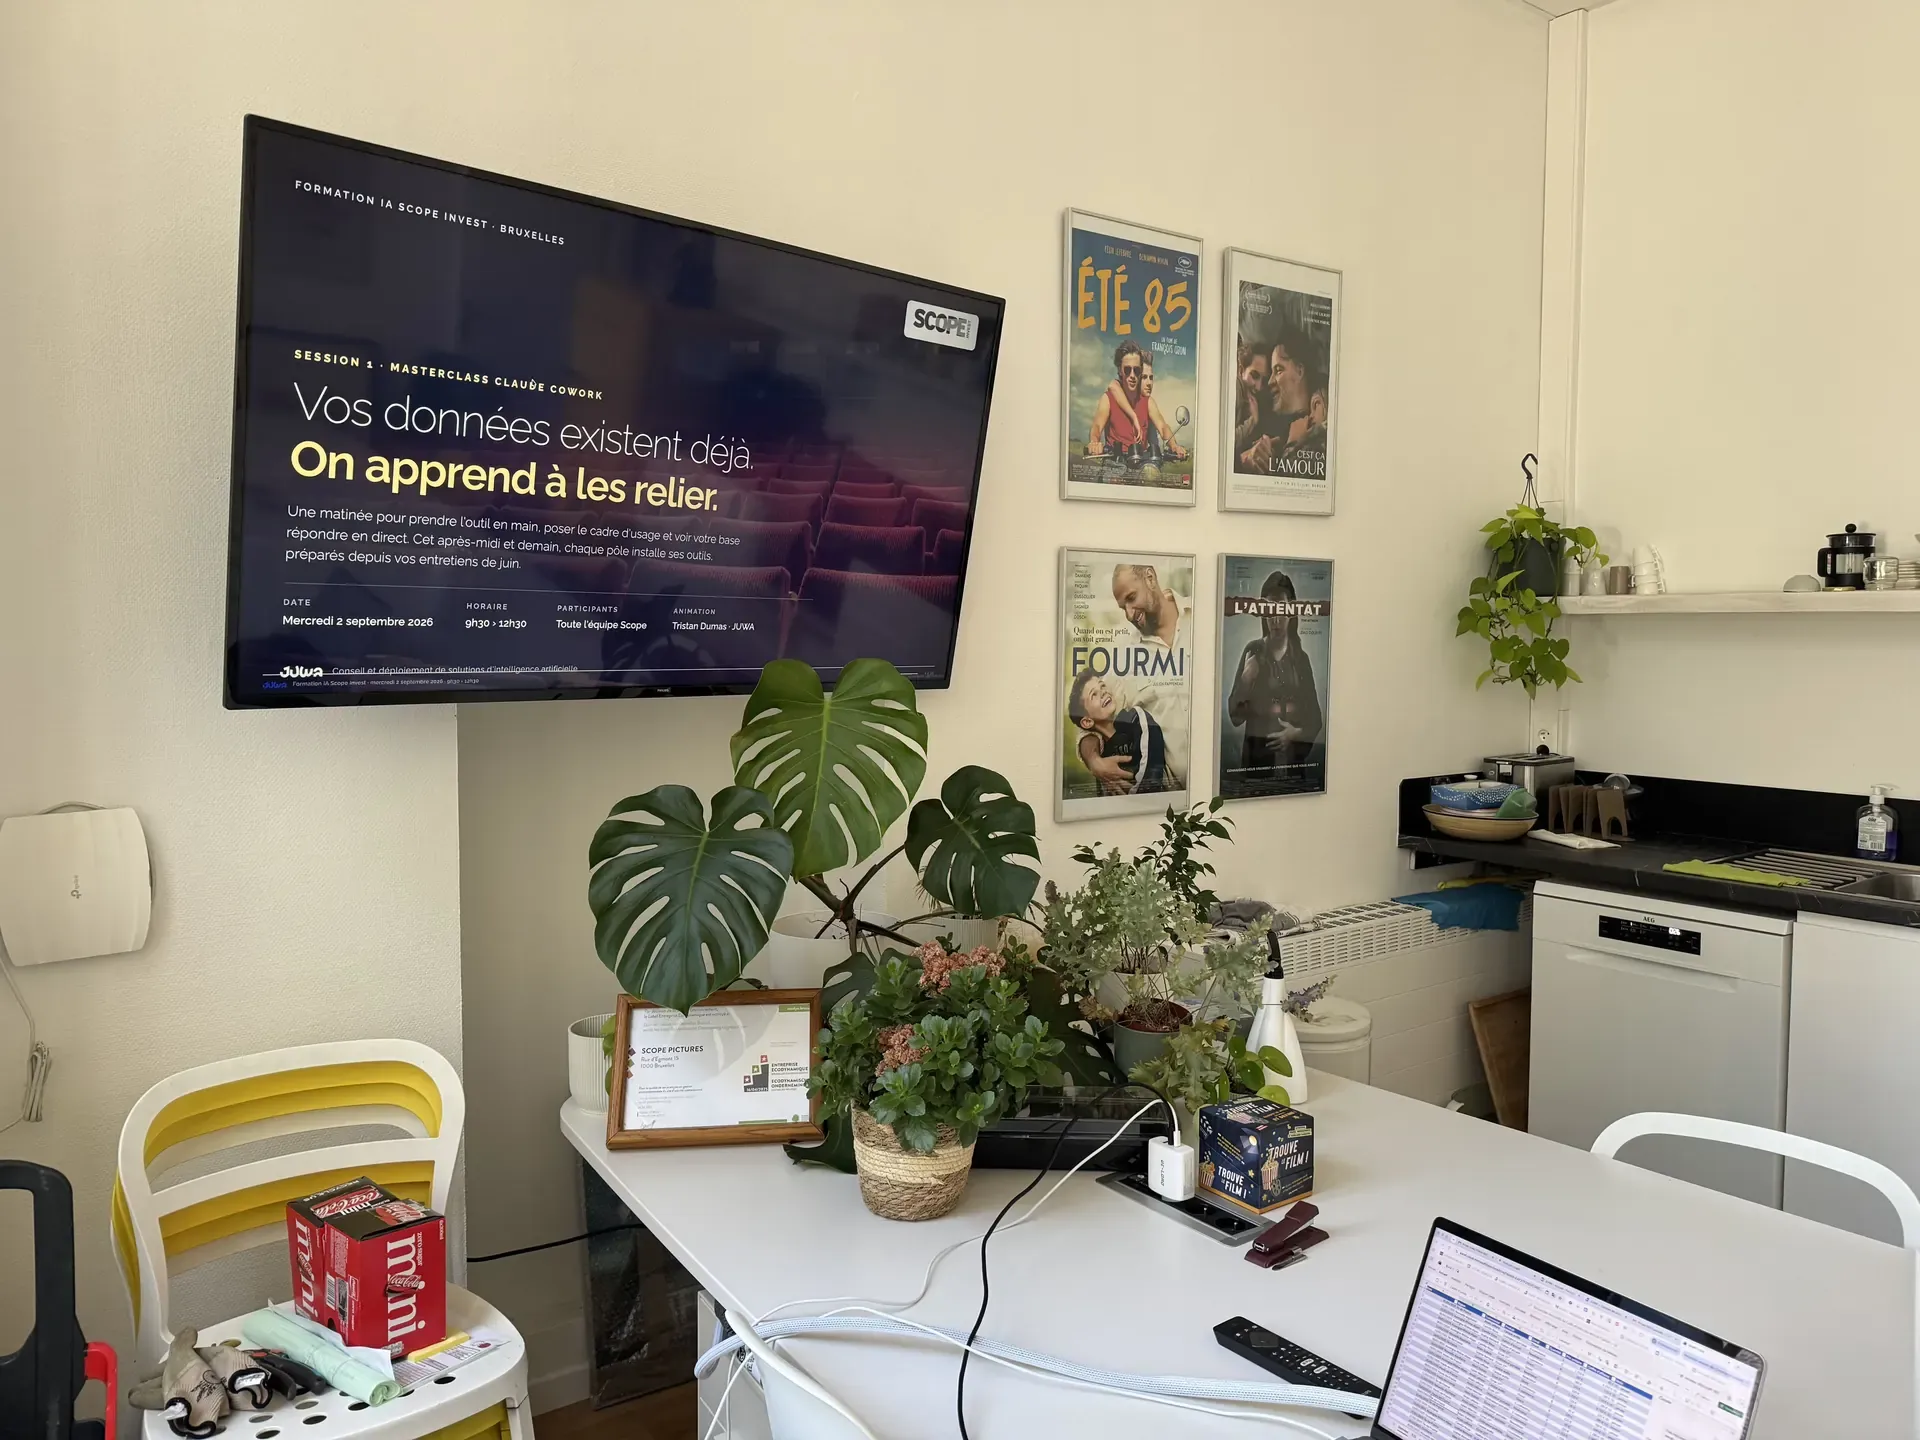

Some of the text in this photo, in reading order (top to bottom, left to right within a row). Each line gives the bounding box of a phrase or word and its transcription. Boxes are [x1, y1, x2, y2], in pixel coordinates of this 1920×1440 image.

[295, 180, 565, 245] FORMATION IA SCOPE INVEST BRUXELLES
[1077, 256, 1192, 335] ÉTÉ 85
[913, 308, 967, 338] SCOPE
[294, 350, 360, 367] SESSION
[366, 361, 373, 369] 1
[390, 363, 489, 384] MASTERCLASS
[550, 385, 603, 400] COWORK
[294, 382, 754, 474] Vos données existent déjà.
[291, 440, 718, 511] On apprend à les relier.
[1269, 457, 1325, 476] L'AMOUR
[288, 505, 741, 546] Une matinée pour prendre l'outil en main, poser le cadre d'usage et voir votre base
[286, 526, 713, 562] répondre en direct. Cet après-midi et demain, chaque pôle installe ses outils.
[285, 549, 522, 570] préparés depuis vos entretiens de juin.
[283, 598, 311, 607] DATE
[466, 602, 508, 611] HORAIRE
[557, 604, 618, 613] PARTICIPANTS
[1234, 602, 1322, 616] L'ATTENTAT
[282, 615, 434, 629] Mercredi 2 septembre 2026
[465, 619, 527, 629] 9h30 12h30
[556, 620, 647, 631] Toute l'équipe Scope
[672, 621, 755, 631] Tristan Dumas JUWA
[1073, 627, 1095, 635] Quand
[332, 667, 365, 675] Conseil
[379, 666, 433, 676] déploiement
[541, 664, 578, 673] artificielle
[1072, 647, 1185, 677] FOURMI
[668, 1045, 704, 1053] PICTURES
[1268, 1140, 1298, 1161] TROUVE
[1285, 1152, 1304, 1170] FILM
[1218, 1165, 1245, 1186] TROUVE
[1224, 1180, 1242, 1197] FILM
[340, 1200, 373, 1216] mini
